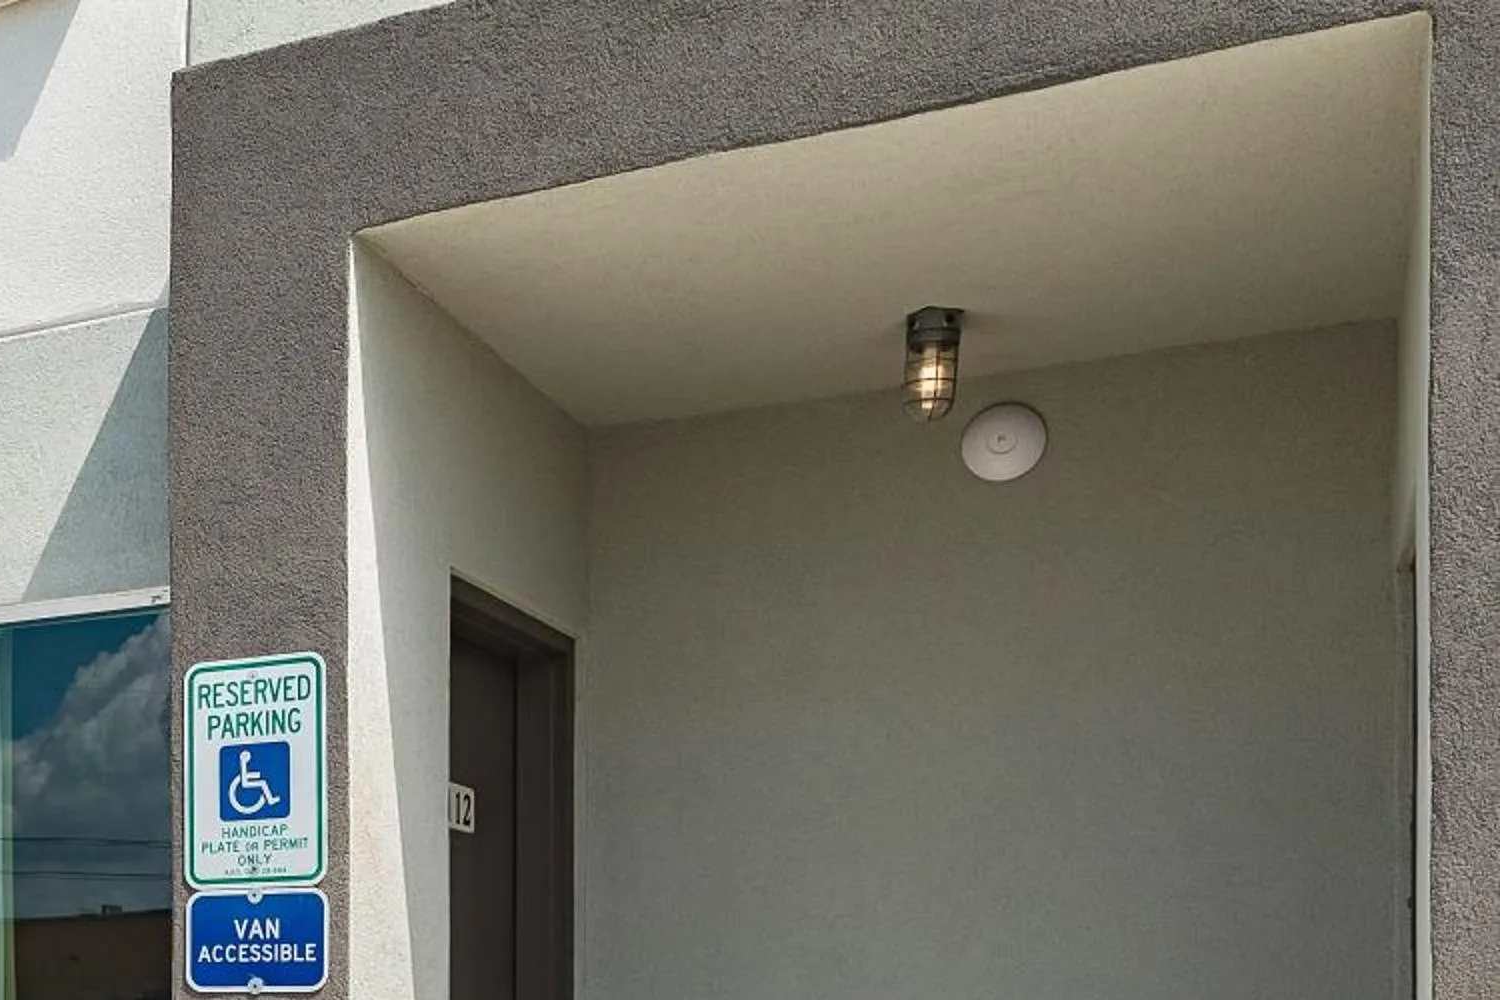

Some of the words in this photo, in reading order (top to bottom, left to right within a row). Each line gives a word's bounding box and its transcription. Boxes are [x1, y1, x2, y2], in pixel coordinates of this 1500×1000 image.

[197, 674, 312, 710] RESERVED
[207, 707, 301, 741] PARKING
[221, 823, 288, 839] HANDICAP
[201, 839, 240, 854] PLATE
[246, 841, 259, 852] OR
[263, 837, 309, 851] PERMIT
[237, 853, 272, 867] ONLY
[233, 917, 280, 940] VAN
[197, 943, 317, 963] ACCESSIBLE
